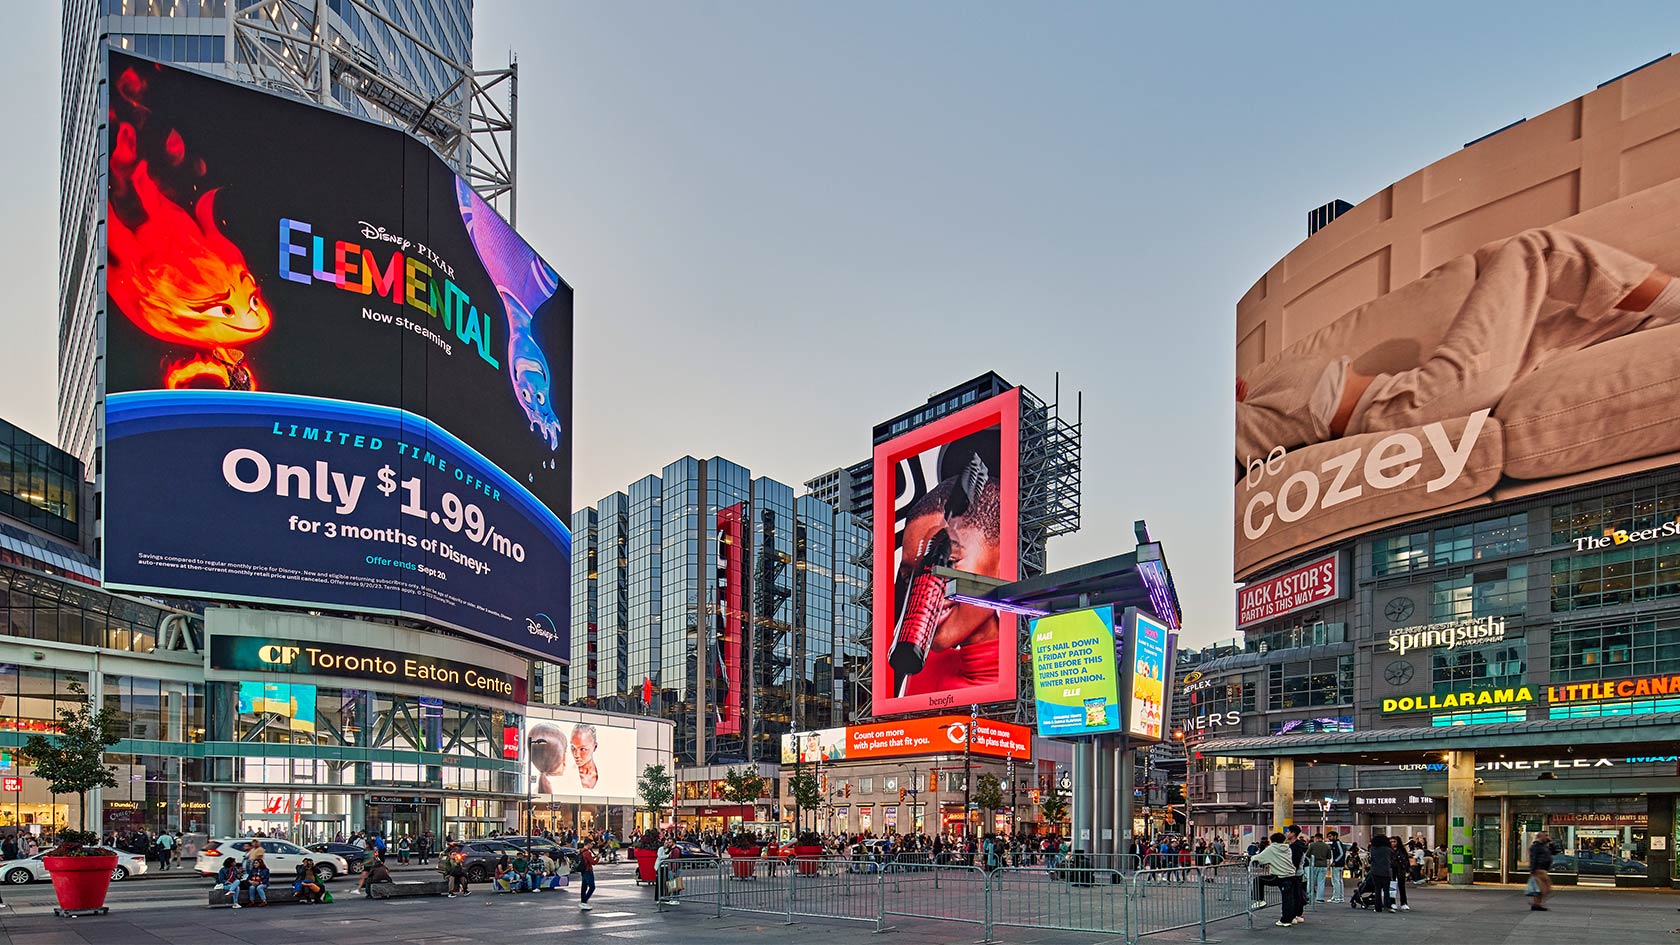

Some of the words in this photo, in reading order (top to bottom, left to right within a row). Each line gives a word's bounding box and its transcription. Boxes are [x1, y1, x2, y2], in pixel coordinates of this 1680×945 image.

[418, 243, 456, 280] PIXAR
[279, 218, 500, 370] ELEMENTAL
[362, 308, 392, 324] Now
[396, 317, 452, 356] streaming
[272, 422, 383, 450] LIMITED
[398, 442, 447, 472] TIME
[454, 468, 500, 502] OFFER
[1243, 408, 1492, 540] cozey
[1246, 445, 1286, 491] be
[222, 448, 366, 515] Only
[289, 516, 320, 534] for
[324, 524, 337, 538] 3
[340, 526, 418, 548] months
[420, 532, 438, 554] of
[440, 542, 492, 575] Disney+
[1572, 536, 1610, 552] The
[138, 552, 164, 561] Savings
[164, 556, 196, 565] compared
[228, 562, 252, 570] monthly
[328, 572, 350, 580] eligible
[138, 560, 180, 568] auto-renews
[187, 564, 228, 574] then-current
[228, 568, 253, 576] monthly
[366, 555, 392, 567] Offer
[393, 560, 416, 571] ends
[417, 564, 436, 578] Sept
[437, 571, 447, 580] 20.
[1241, 584, 1272, 612] JACK
[1274, 562, 1332, 600] ASTOR'S
[1242, 605, 1264, 623] PARTY
[1266, 602, 1274, 615] IS
[1274, 596, 1293, 612] THIS
[1294, 589, 1314, 606] WAY
[525, 614, 559, 644] Disney+
[1036, 645, 1051, 654] LET'S
[1052, 642, 1070, 651] NAIL
[1072, 638, 1100, 648] DOWN
[1043, 652, 1066, 660] FRIDAY
[1068, 648, 1092, 658] PATIO
[258, 645, 300, 664] CF
[306, 648, 397, 675] Toronto
[404, 659, 460, 684] Eaton
[464, 670, 513, 696] Centre
[1040, 670, 1058, 680] TURNS
[1054, 658, 1082, 668] BEFORE
[1084, 656, 1102, 664] THIS
[1040, 679, 1064, 688] WINTER
[1066, 674, 1106, 684] REUNION.
[1063, 688, 1080, 697] ELLE
[929, 694, 954, 706] benefit
[1382, 687, 1533, 713] DOLLARAMA
[854, 732, 874, 740] Count
[854, 741, 868, 750] with
[870, 740, 888, 750] plans
[889, 738, 903, 747] that
[904, 737, 912, 746] fit
[914, 737, 930, 747] you.
[977, 736, 986, 744] ith
[986, 737, 999, 748] plans
[1000, 739, 1010, 748] that
